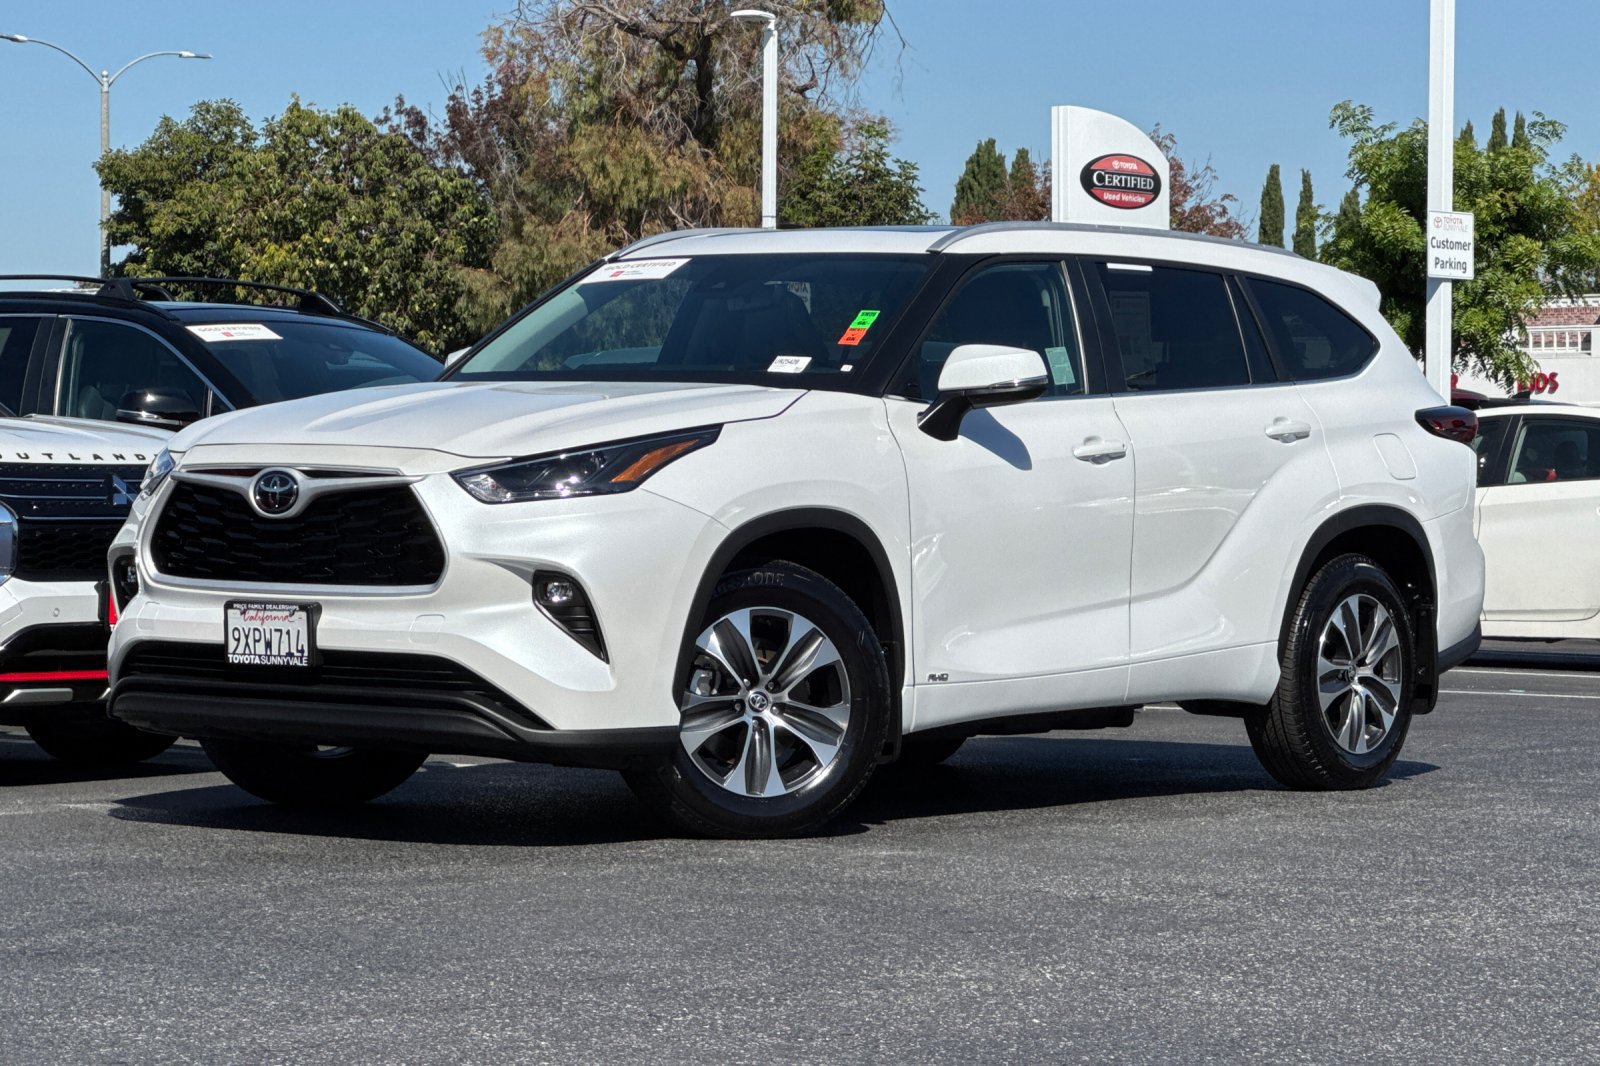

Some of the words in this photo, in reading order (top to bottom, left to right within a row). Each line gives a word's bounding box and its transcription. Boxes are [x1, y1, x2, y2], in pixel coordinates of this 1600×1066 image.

[1119, 161, 1138, 170] TOYOTA
[1093, 171, 1154, 190] CERTIFIED
[1103, 192, 1120, 200] Used
[1121, 193, 1145, 203] Vehicles
[1443, 216, 1463, 225] TOYOTA
[1430, 236, 1471, 251] Customer
[1434, 256, 1467, 274] Parking
[243, 608, 294, 625] California
[232, 626, 305, 656] 9XPW714
[228, 654, 261, 664] TOYOTA
[261, 656, 309, 666] SUNNYVALE
